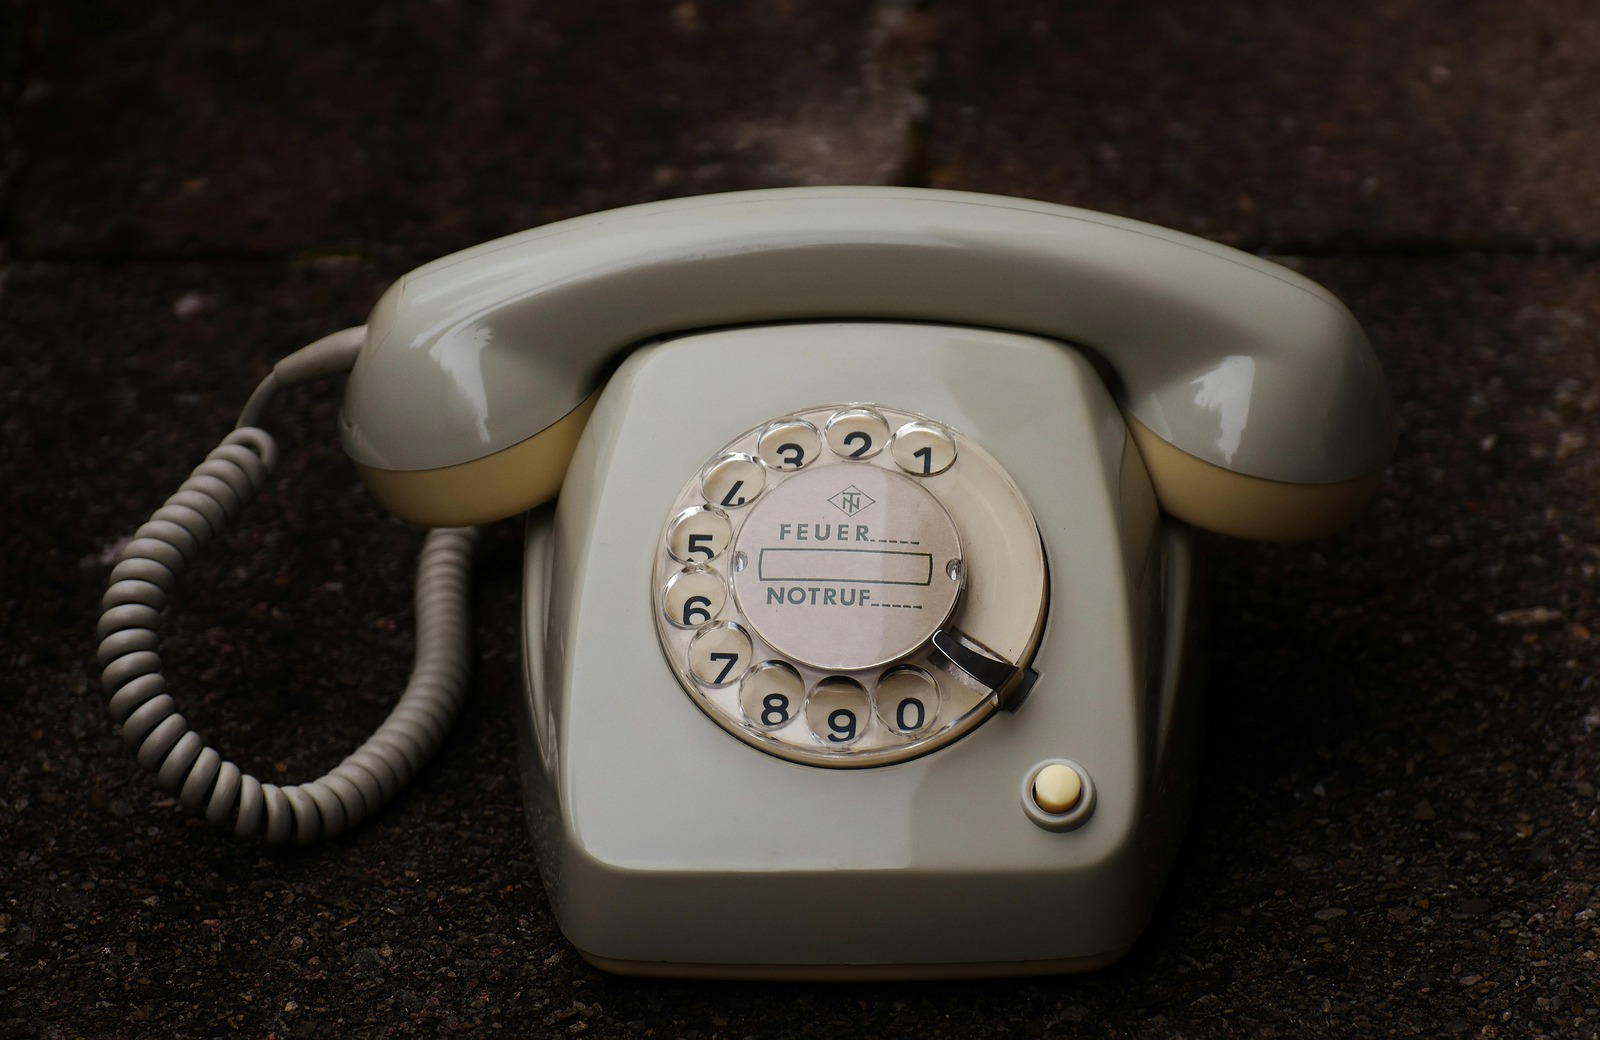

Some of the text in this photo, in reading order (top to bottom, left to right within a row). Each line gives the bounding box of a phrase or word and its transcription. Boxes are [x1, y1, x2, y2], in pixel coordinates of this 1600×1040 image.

[776, 443, 805, 468] 3
[843, 431, 872, 457] 2
[913, 447, 932, 473] 1
[720, 480, 746, 506] 4
[779, 523, 869, 542] FEUER
[687, 534, 714, 561] 5
[766, 587, 870, 607] NOTRUF
[682, 596, 712, 625] 6
[710, 652, 739, 684] 7
[761, 693, 789, 725] 8
[827, 708, 857, 742] 9
